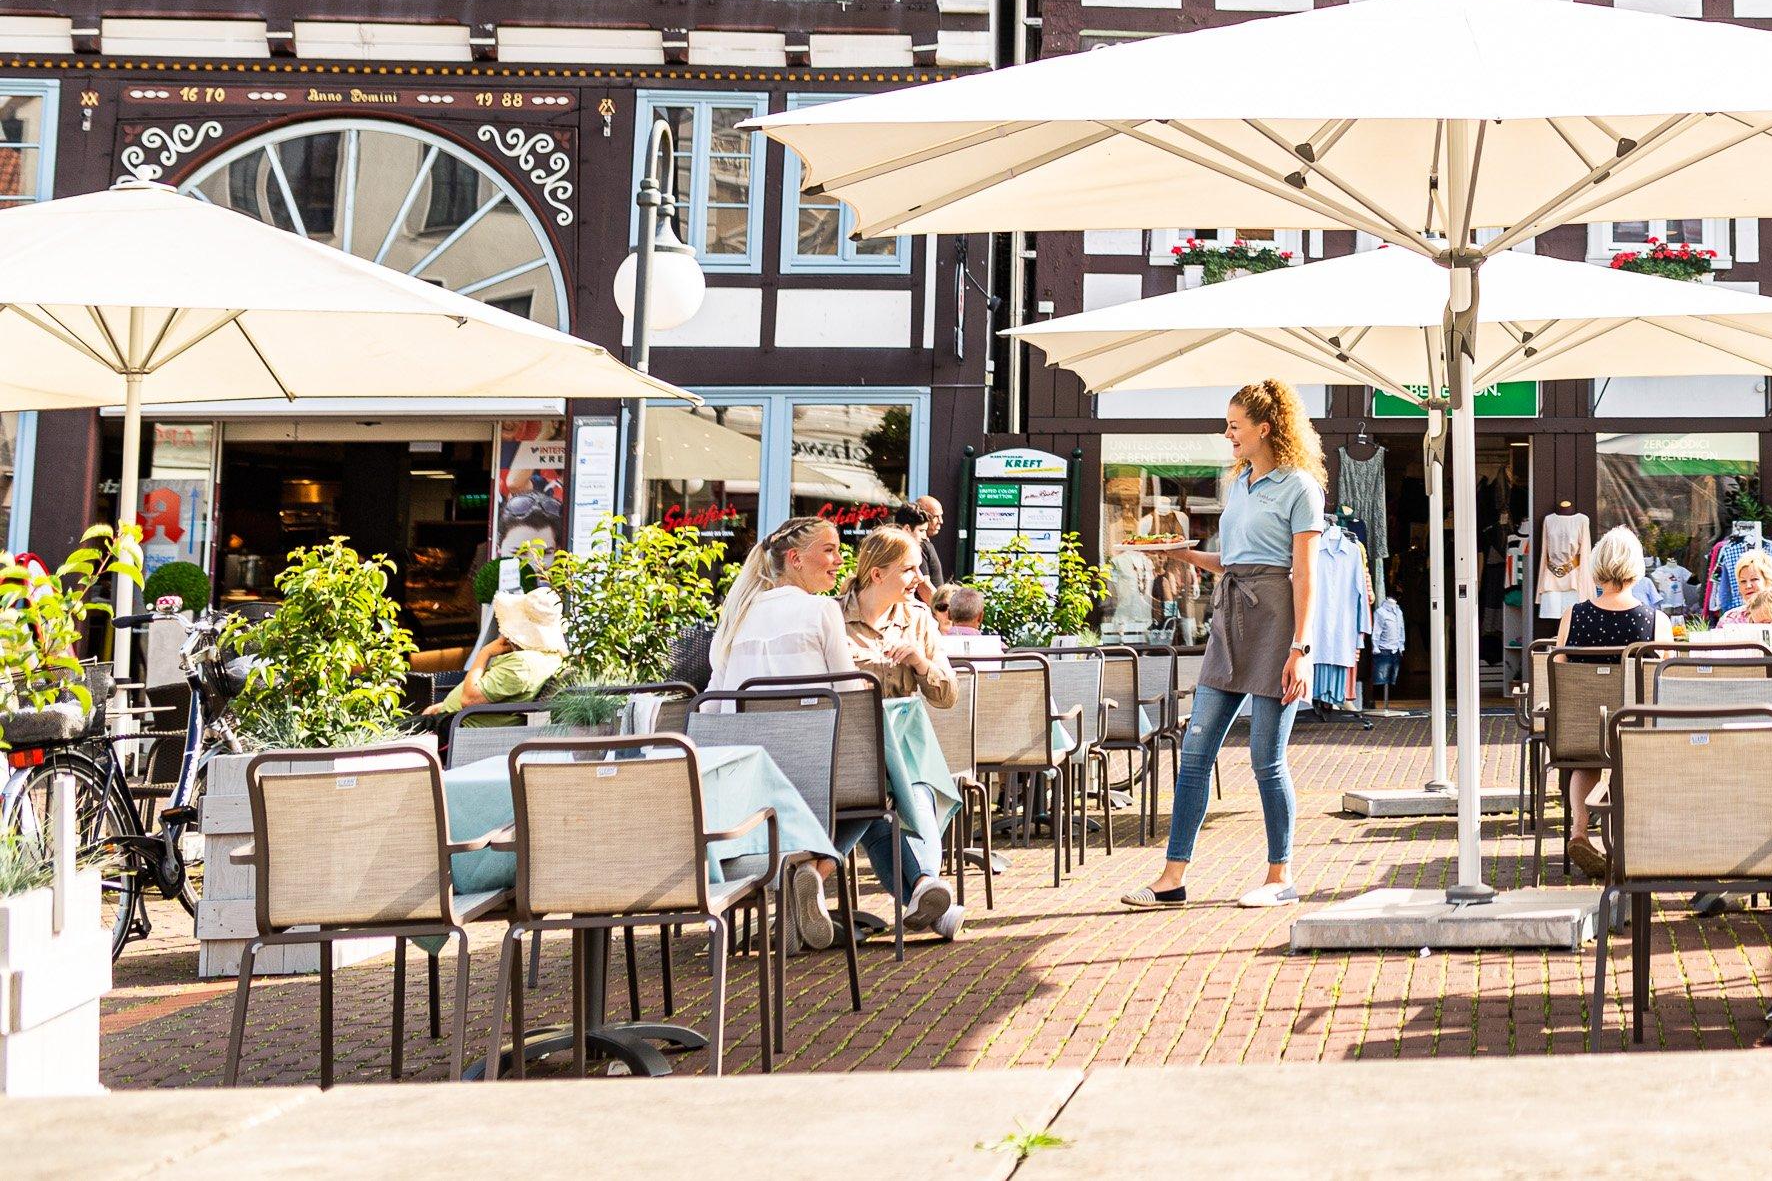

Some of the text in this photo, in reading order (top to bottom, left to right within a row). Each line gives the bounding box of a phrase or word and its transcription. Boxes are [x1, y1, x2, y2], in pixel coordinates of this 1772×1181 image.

[308, 88, 342, 103] Anno
[350, 89, 397, 104] Domini
[1005, 459, 1043, 468] KREFT
